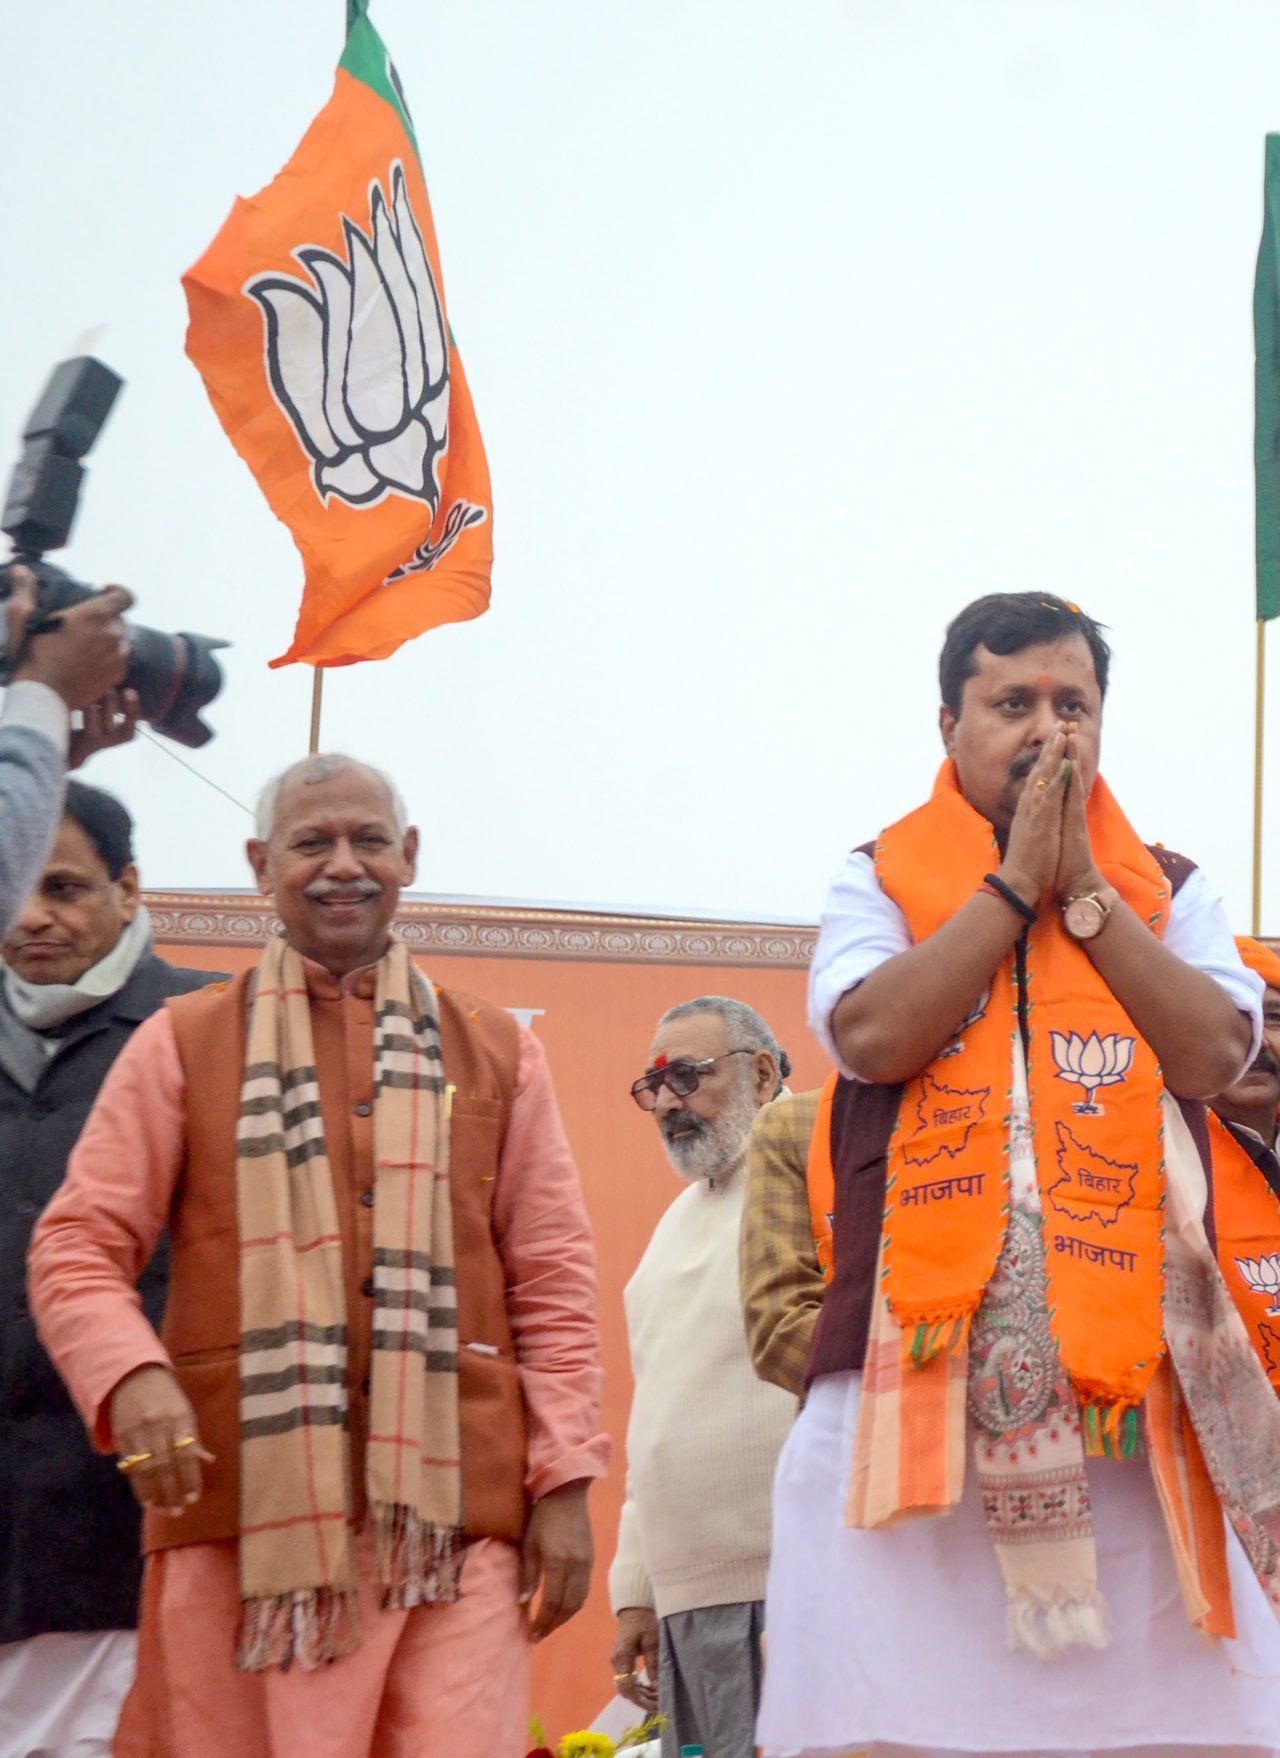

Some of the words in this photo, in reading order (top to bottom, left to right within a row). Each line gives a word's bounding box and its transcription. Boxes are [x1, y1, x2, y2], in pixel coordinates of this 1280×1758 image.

[933, 1105, 973, 1128] बिहार
[900, 1173, 986, 1207] भाजपा
[1077, 1168, 1122, 1193] बिहार
[1054, 1234, 1138, 1272] भाजपा
